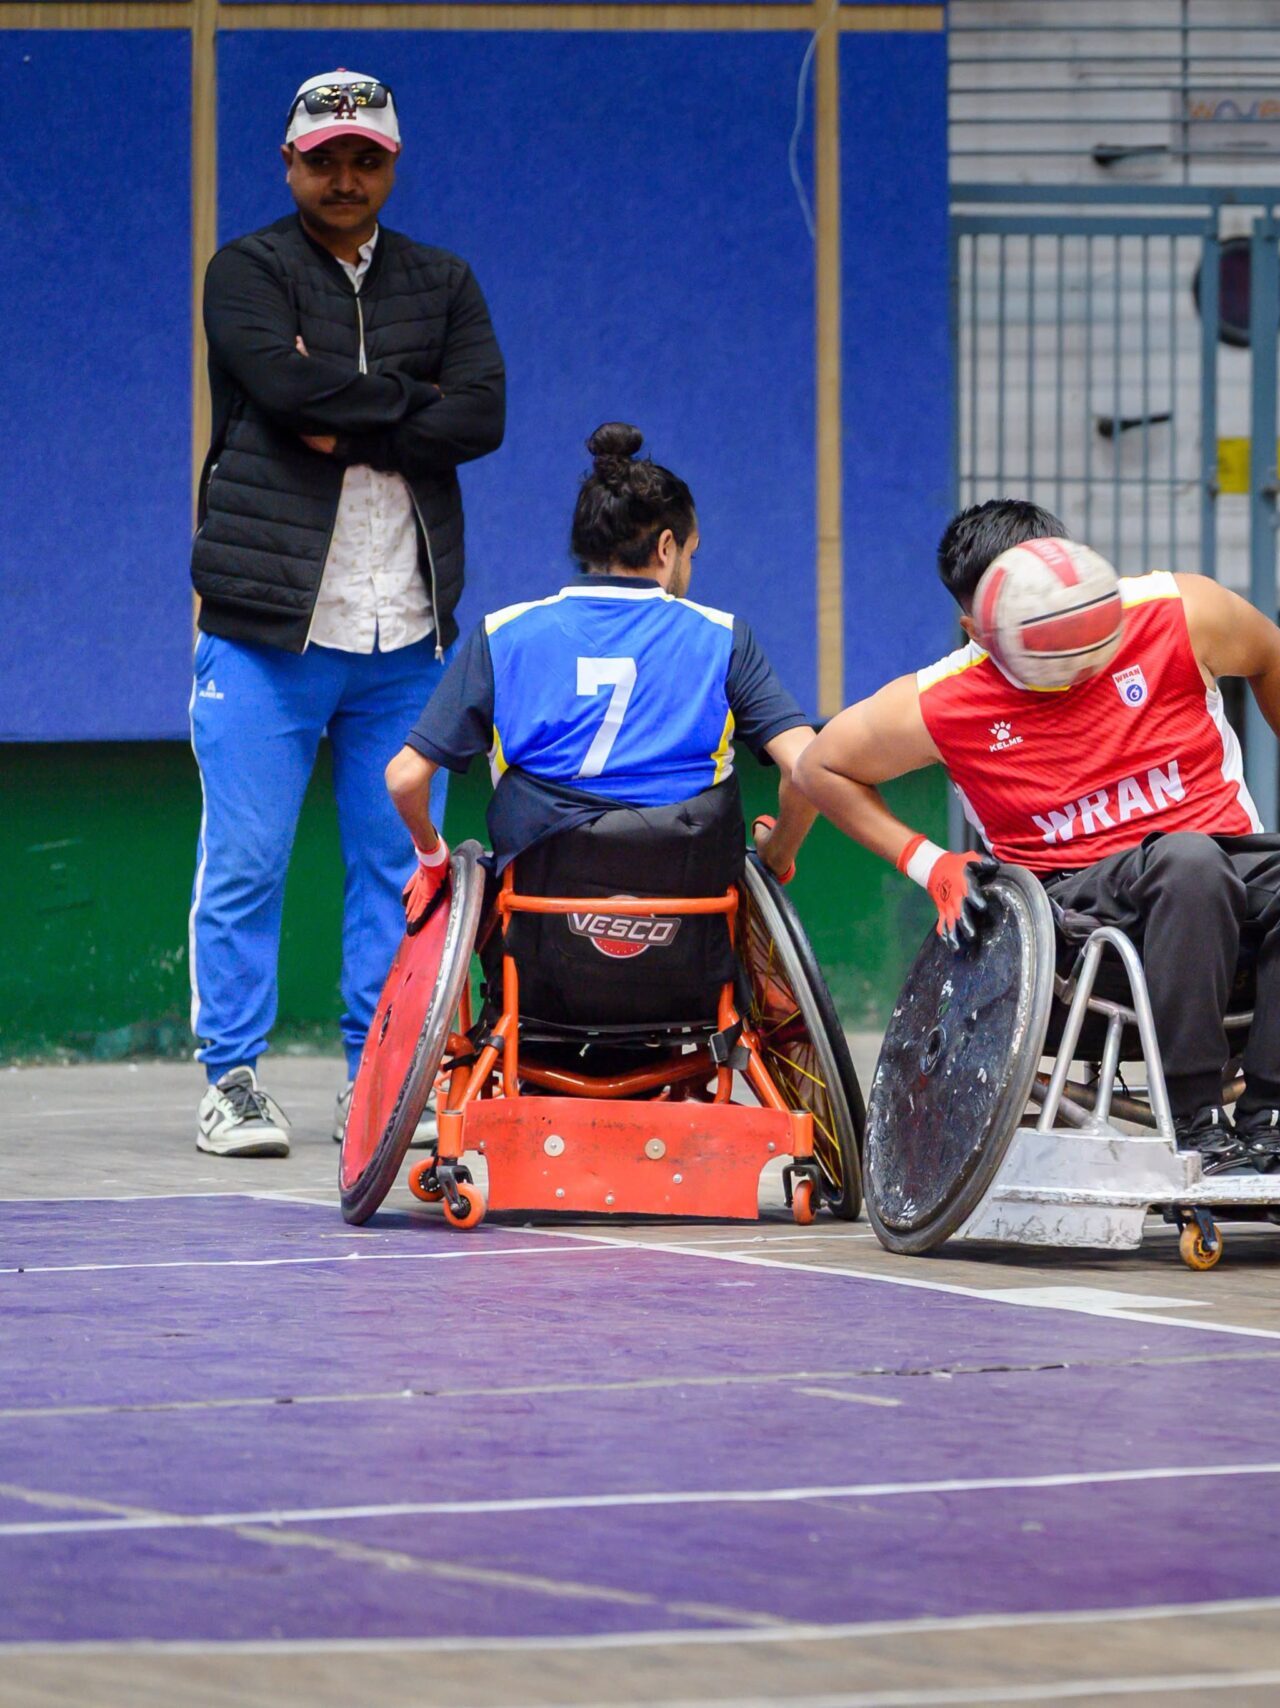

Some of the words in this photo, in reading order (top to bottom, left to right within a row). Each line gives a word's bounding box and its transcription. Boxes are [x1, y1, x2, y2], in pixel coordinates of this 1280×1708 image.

[576, 656, 638, 780] 7
[989, 736, 1024, 752] KELME
[1031, 759, 1186, 844] WRAN
[572, 912, 673, 941] VESCO
